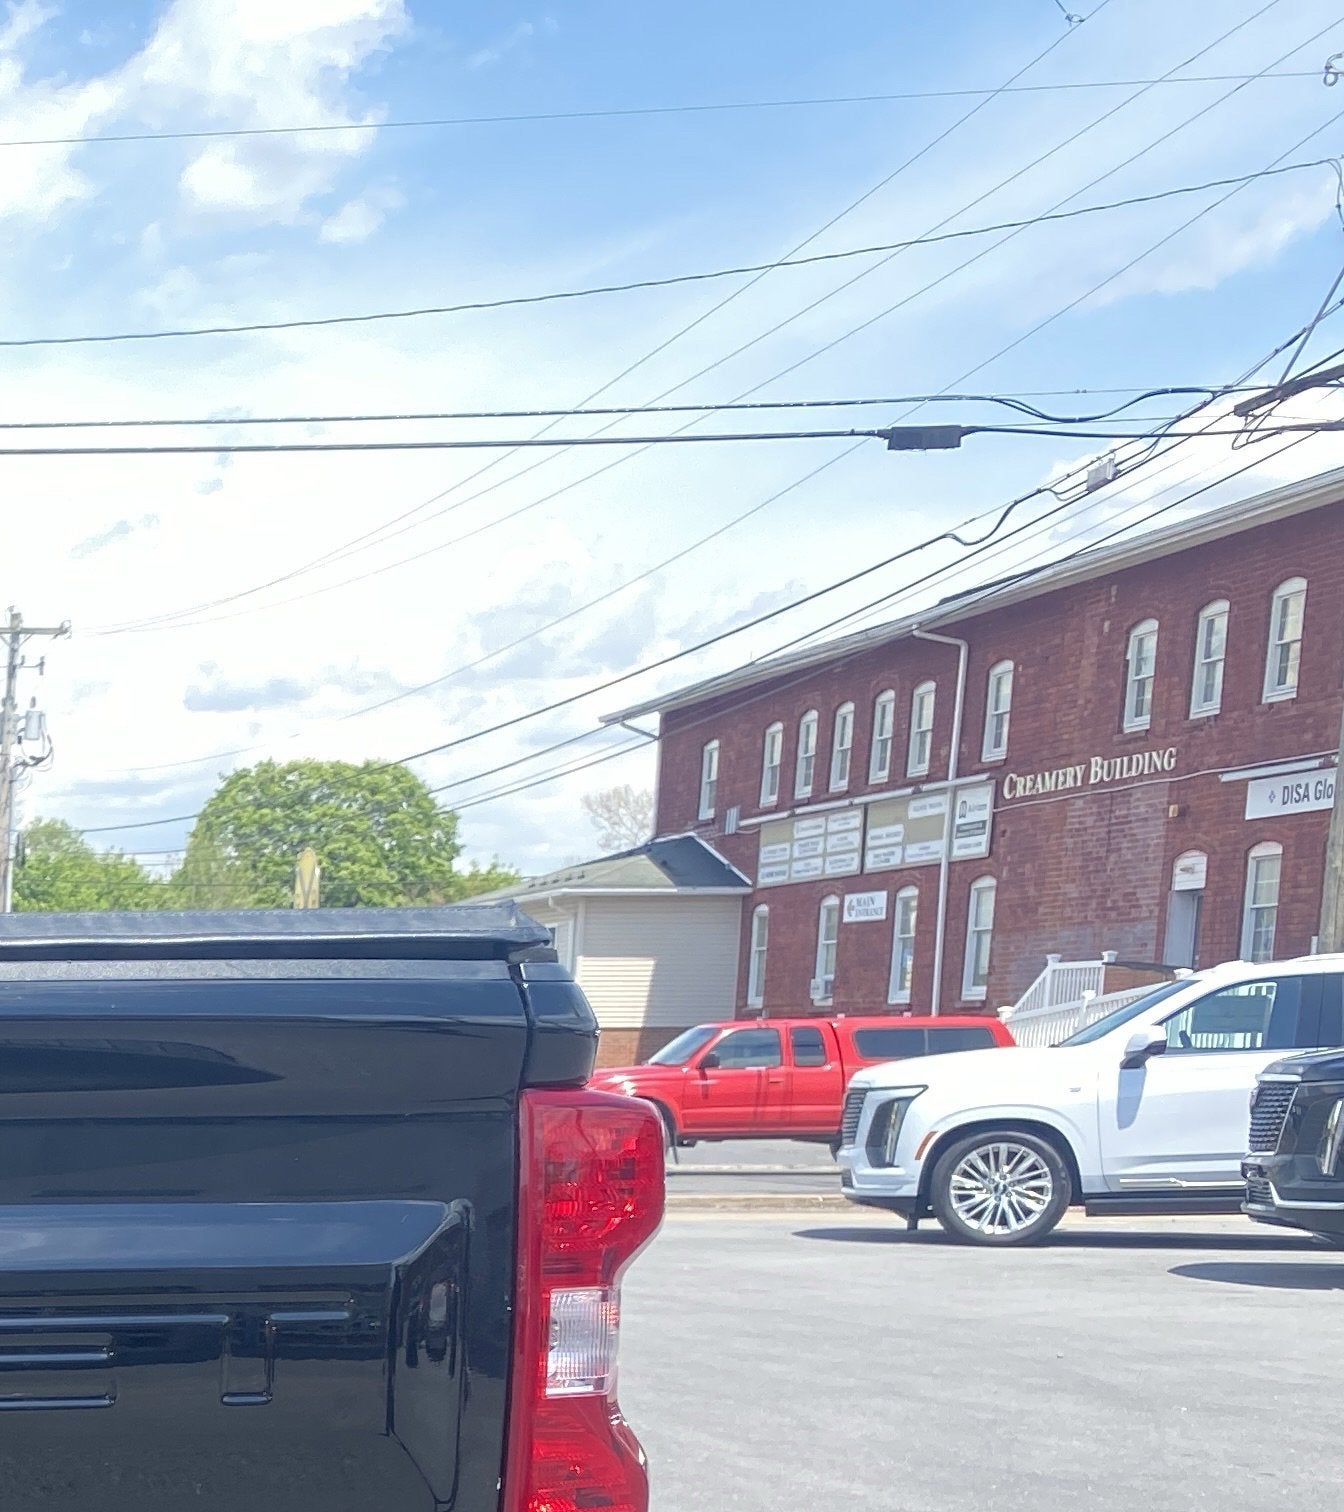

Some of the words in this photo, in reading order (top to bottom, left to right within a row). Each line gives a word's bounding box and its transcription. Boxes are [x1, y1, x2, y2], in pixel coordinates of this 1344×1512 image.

[1003, 764, 1086, 800] CREAMERY
[1089, 747, 1178, 785] BUILDING
[1282, 782, 1310, 806] DISA
[1314, 778, 1334, 801] Glo
[855, 896, 875, 907] MAIN
